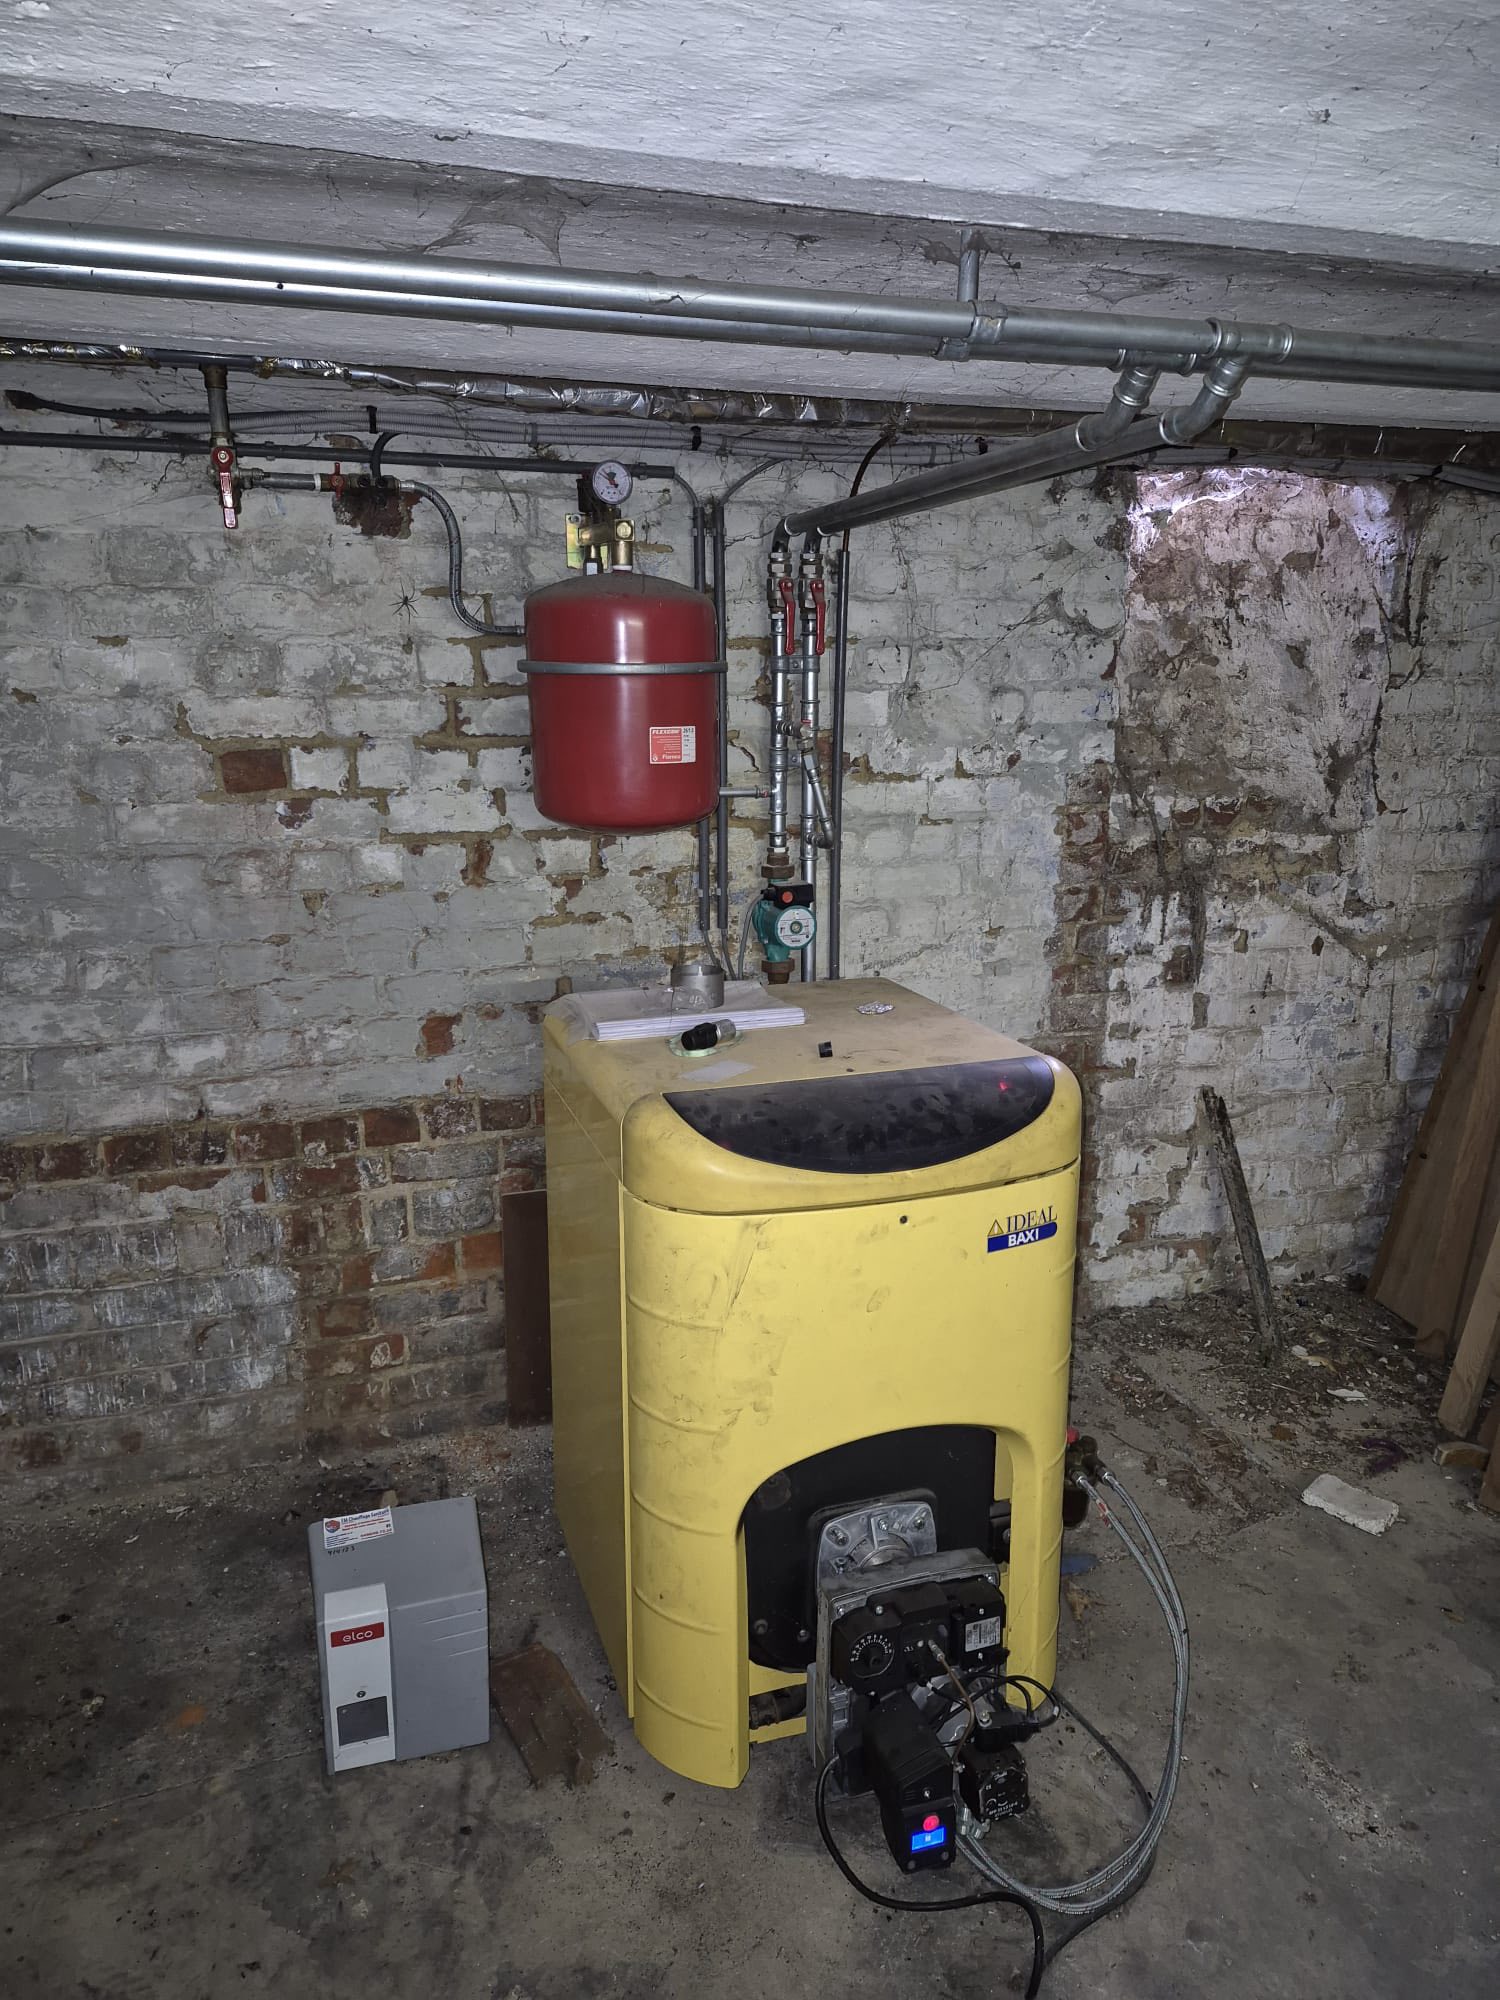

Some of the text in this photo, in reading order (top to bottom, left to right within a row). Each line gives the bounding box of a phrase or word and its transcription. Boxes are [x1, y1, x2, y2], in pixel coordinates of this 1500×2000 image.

[1006, 1205, 1058, 1233] IDEAL
[1008, 1228, 1039, 1247] BAXI
[343, 1630, 373, 1642] elco
